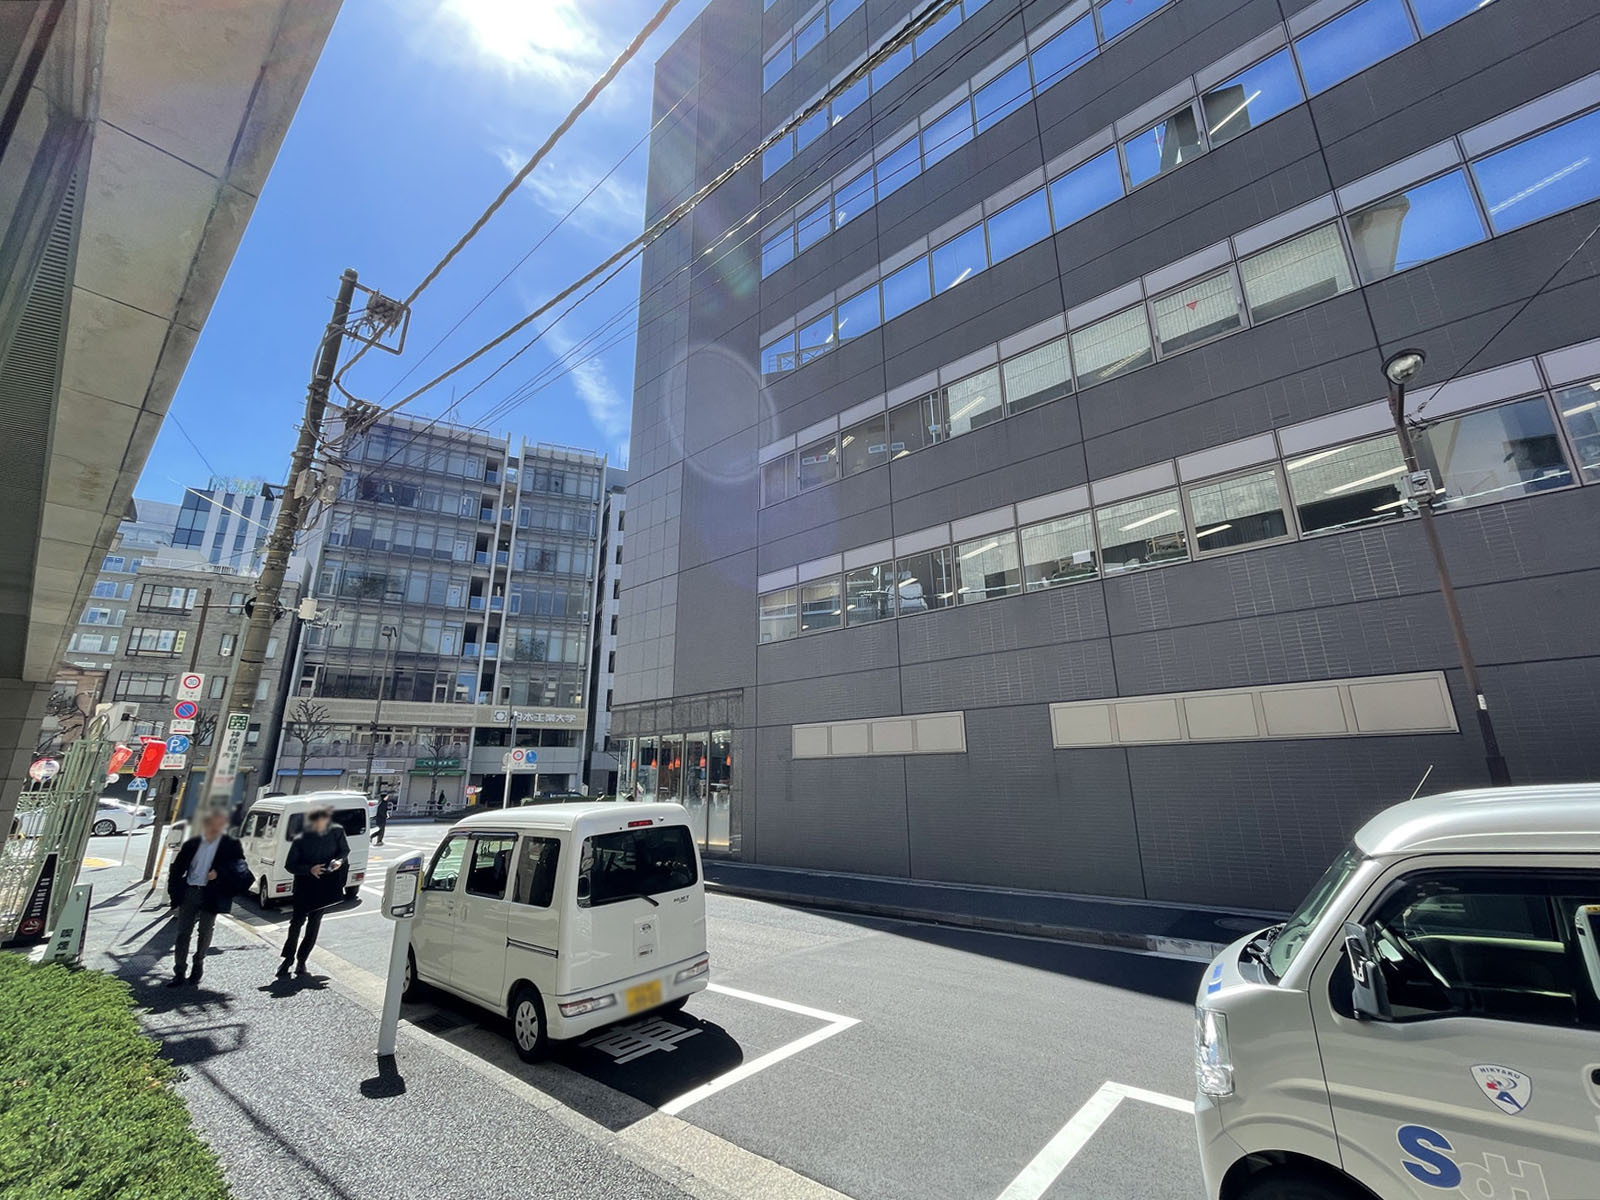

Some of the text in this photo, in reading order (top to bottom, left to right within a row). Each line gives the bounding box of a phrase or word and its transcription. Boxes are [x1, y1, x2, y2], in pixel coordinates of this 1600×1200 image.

[169, 740, 181, 752] P
[55, 929, 74, 956] 喫煙
[1479, 1067, 1521, 1080] HIKYAKU
